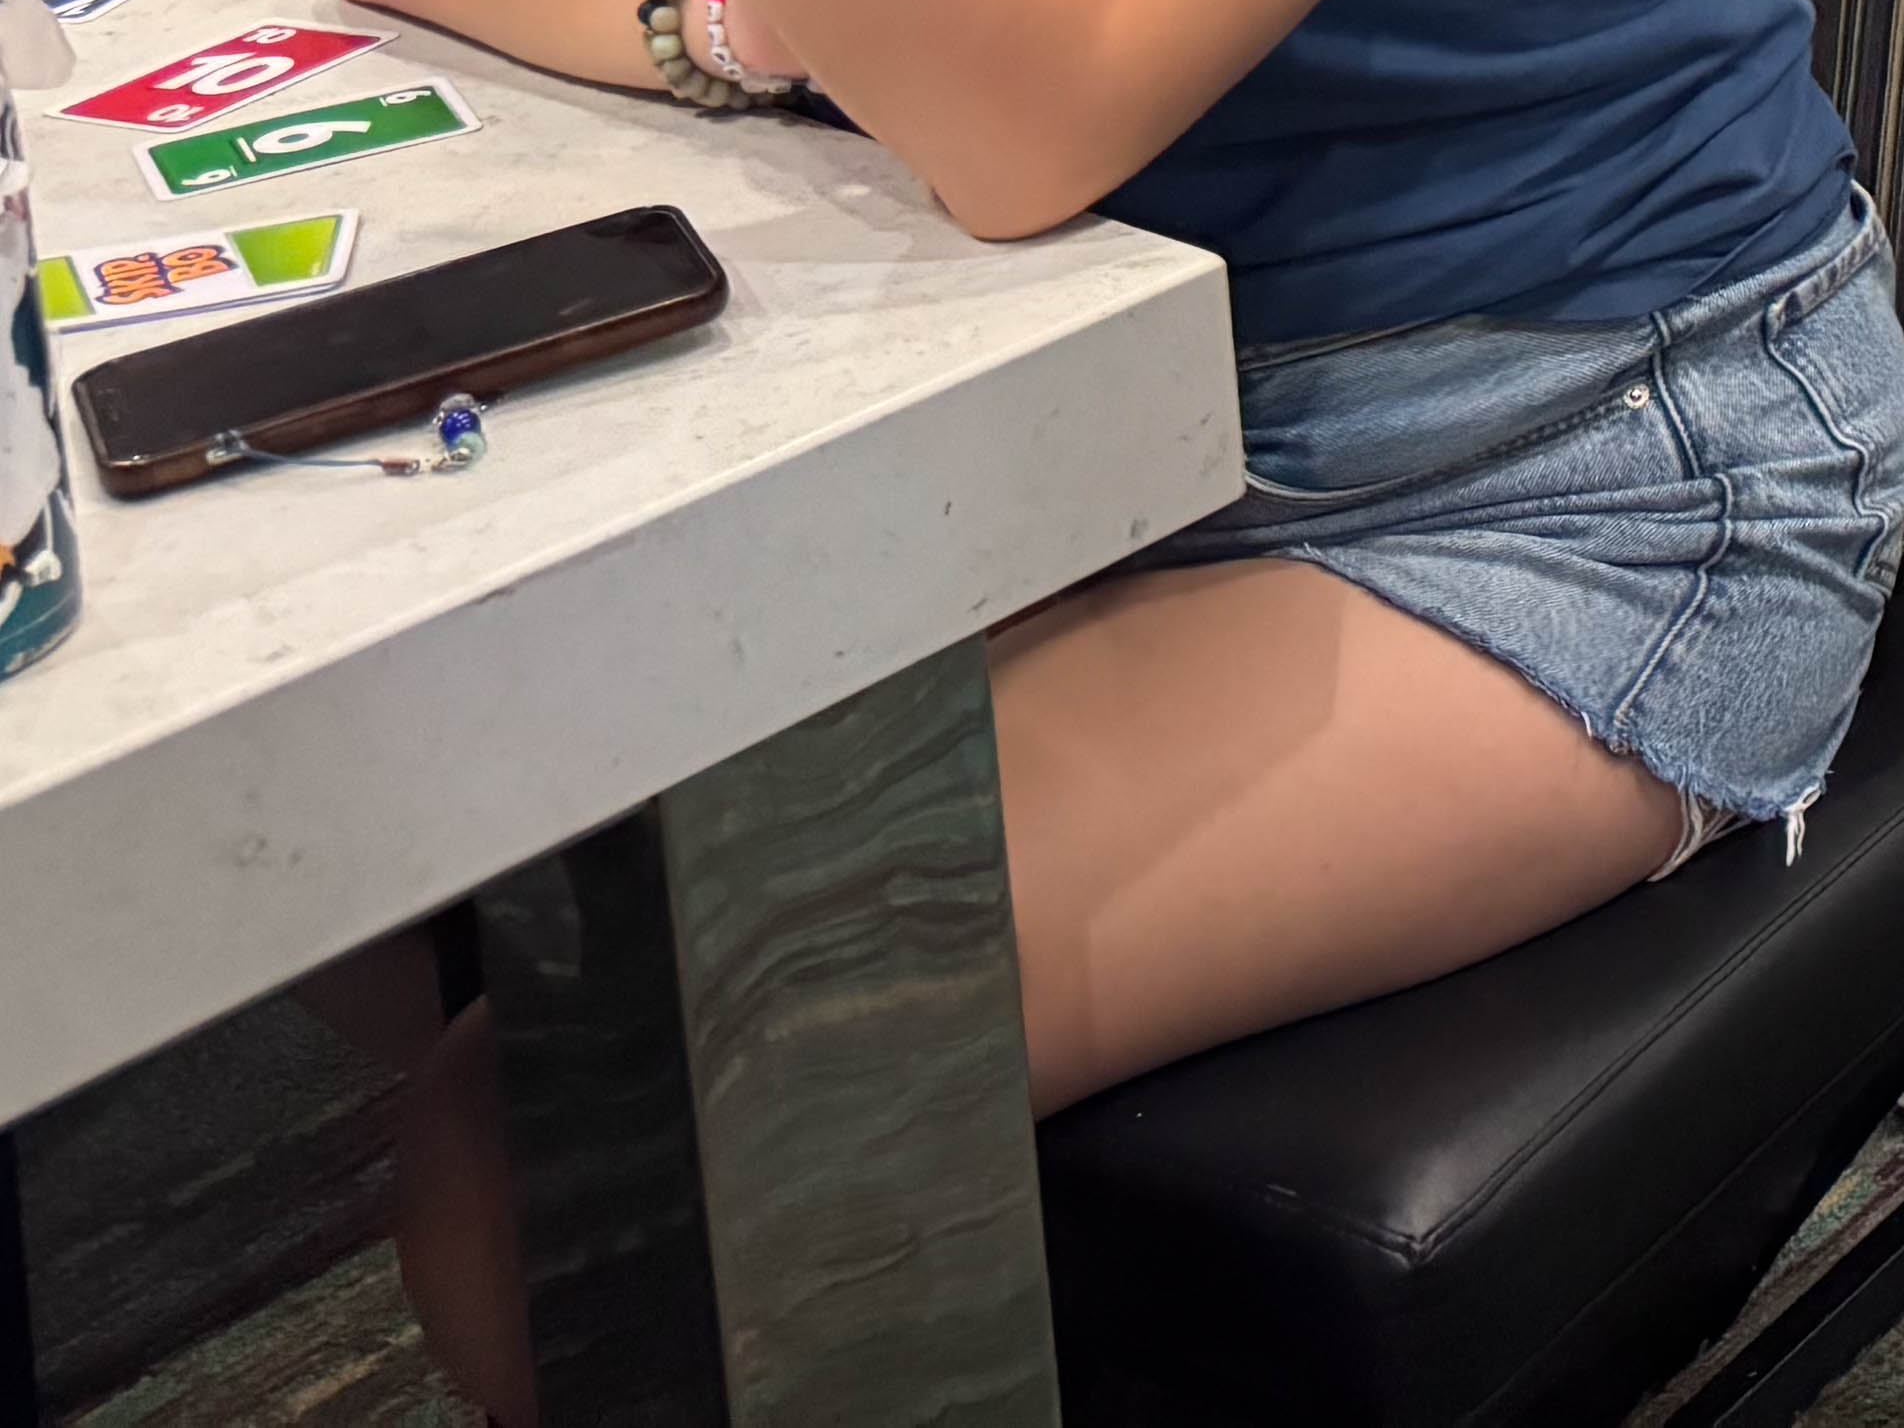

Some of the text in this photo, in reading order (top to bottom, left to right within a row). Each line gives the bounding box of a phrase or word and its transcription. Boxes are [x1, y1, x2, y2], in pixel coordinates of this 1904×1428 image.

[243, 27, 297, 45] 10
[152, 52, 295, 96] 10
[386, 89, 432, 105] 6
[146, 104, 205, 124] 10
[252, 120, 372, 154] 6
[180, 168, 231, 186] 6
